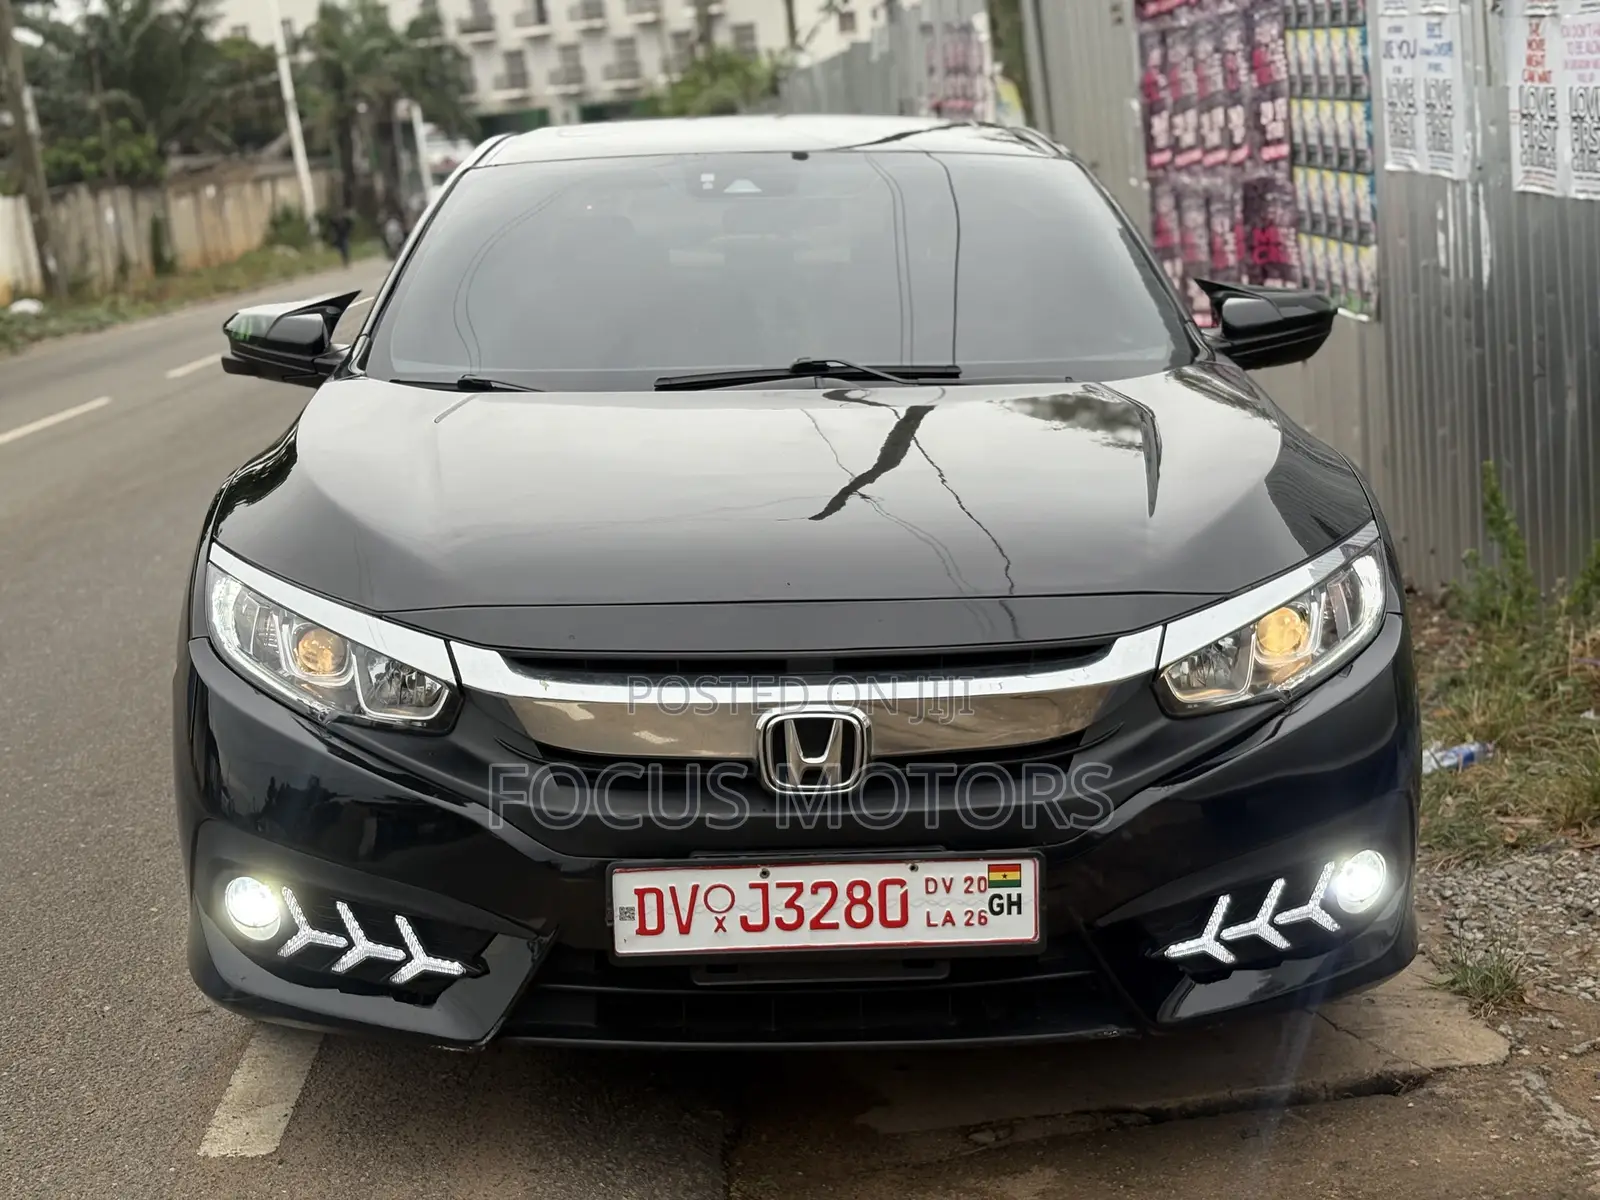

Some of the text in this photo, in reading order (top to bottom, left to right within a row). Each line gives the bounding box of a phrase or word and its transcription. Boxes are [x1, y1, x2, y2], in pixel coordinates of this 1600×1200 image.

[1519, 85, 1556, 120] LOVE
[1519, 120, 1558, 152] FIRST
[924, 875, 988, 895] DV 20
[634, 884, 700, 936] DV
[740, 878, 910, 933] J3280
[926, 909, 988, 927] LA 26
[988, 893, 1022, 916] GH
